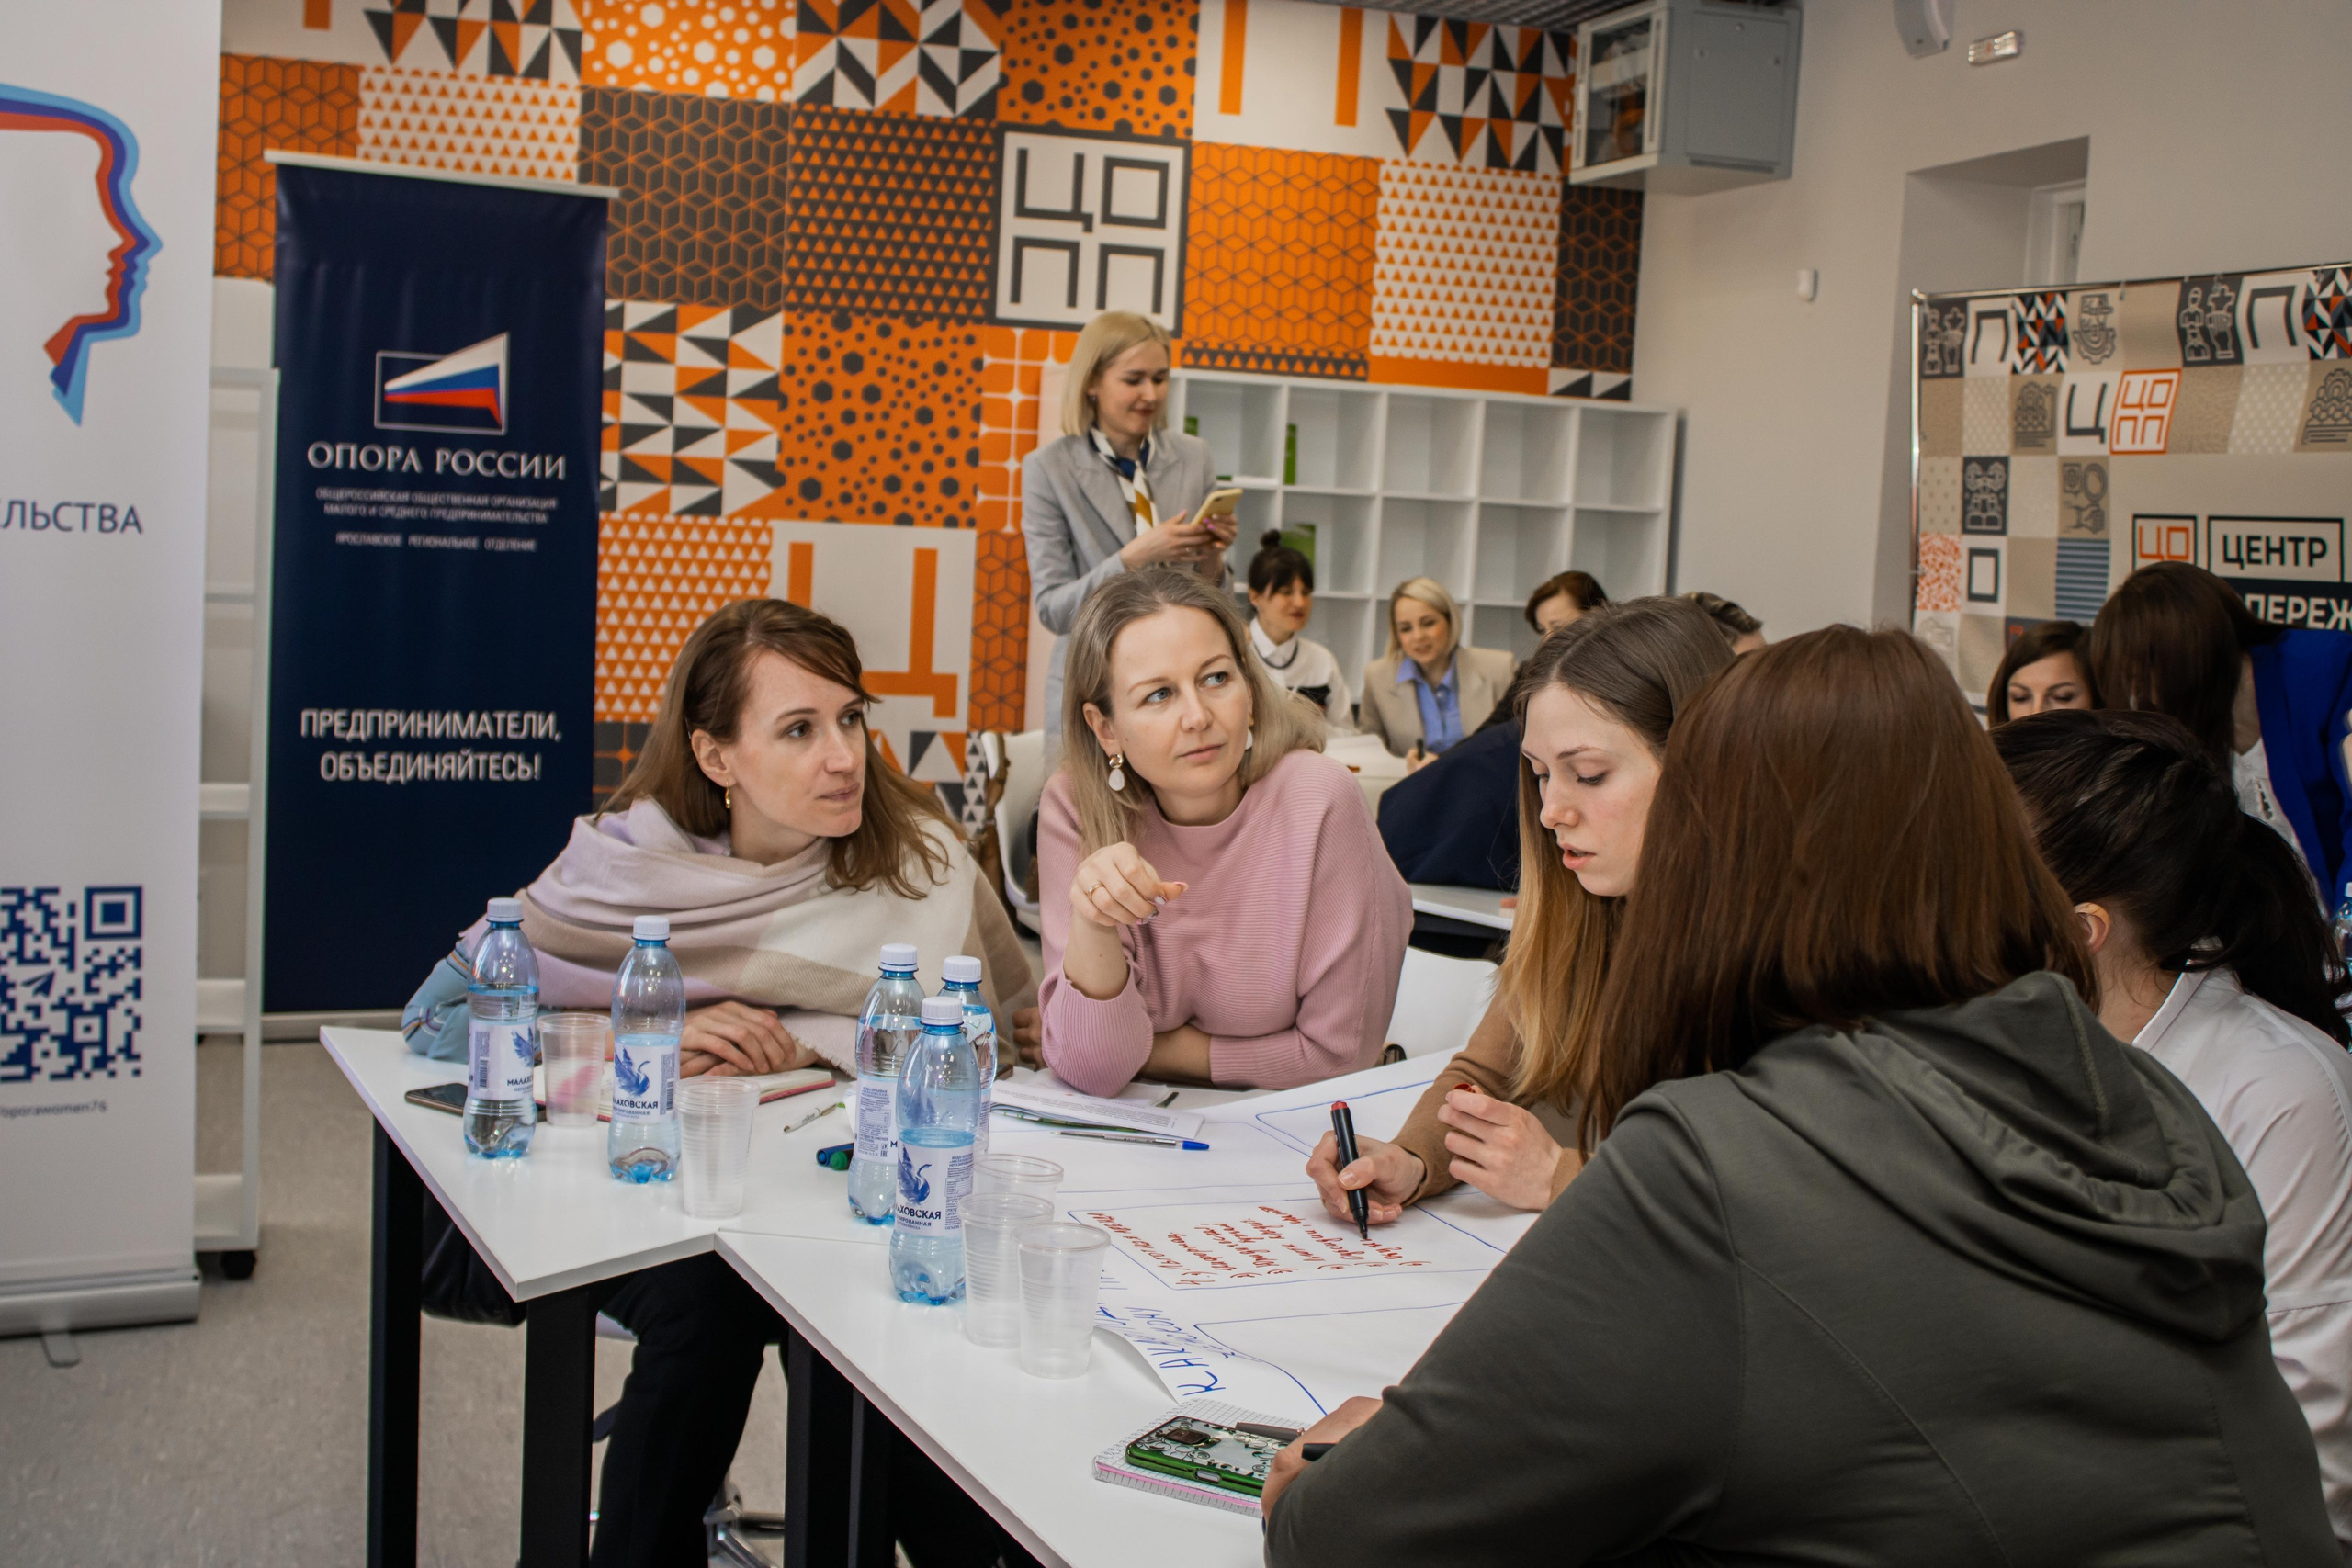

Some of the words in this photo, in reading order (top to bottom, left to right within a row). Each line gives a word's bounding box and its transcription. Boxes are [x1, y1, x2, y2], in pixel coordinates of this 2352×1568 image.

[307, 440, 423, 474] ОПОРА
[435, 447, 567, 481] РОССИИ
[316, 487, 410, 503] ОБЩЕРОССИЙСКАЯ
[411, 491, 489, 507] ОБЩЕСТВЕННАЯ
[491, 495, 558, 510] ОРГАНИЗАЦИЯ
[323, 502, 368, 516] МАЛОГО
[378, 506, 428, 520] СРЕДНЕГО
[429, 507, 548, 524] ПРЕДПРИНИМАТЕЛЬСТВА
[0, 499, 143, 535] ЛЬСТВА
[335, 531, 402, 547] ЯРОСЛАВСКОЕ
[408, 535, 479, 550] РЕГИОНАЛЬНОЕ
[484, 537, 537, 552] ОТДЕЛЕНИЕ
[2222, 534, 2328, 570] ЦЕНТР
[300, 707, 562, 742] ПРЕДПРИНИМАТЕЛИ,
[320, 748, 542, 785] ОБЪЕДИНЯЙТЕСЬ!
